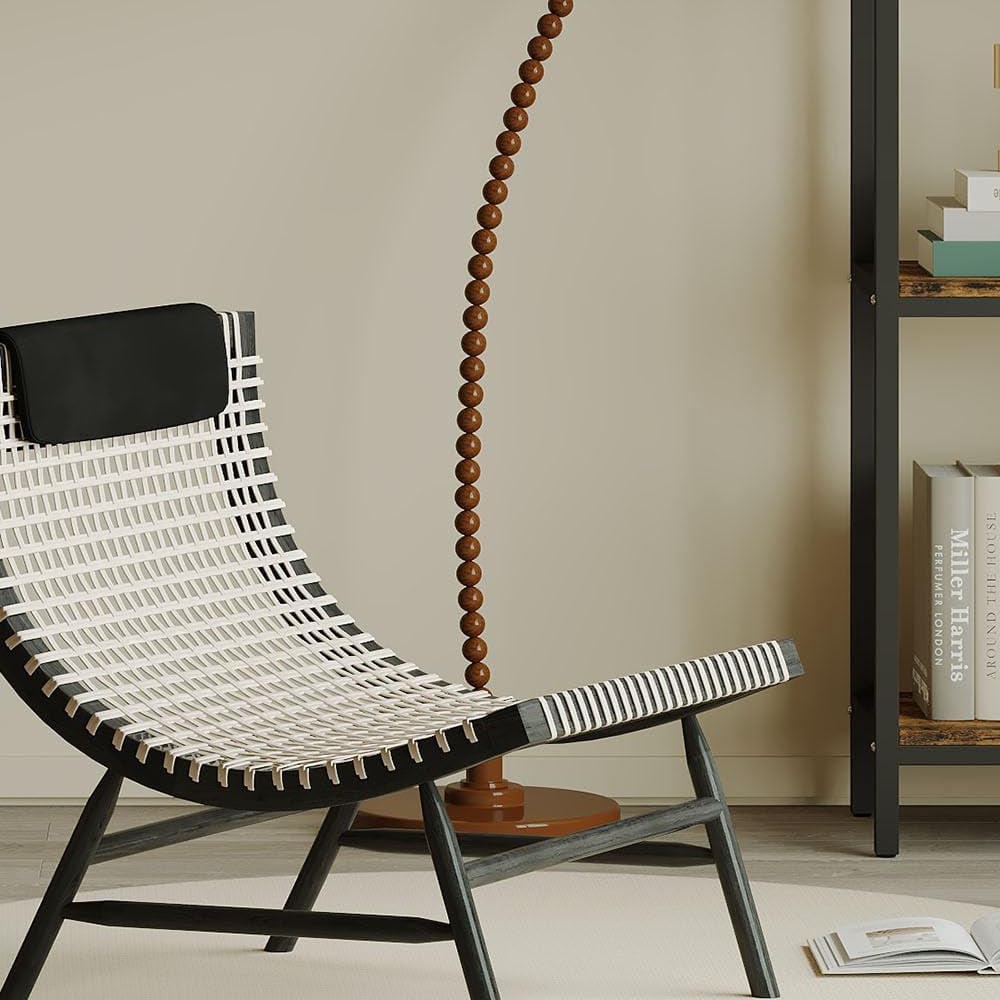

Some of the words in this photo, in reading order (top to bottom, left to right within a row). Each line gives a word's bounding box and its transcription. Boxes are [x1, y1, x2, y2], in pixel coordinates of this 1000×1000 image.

[950, 528, 969, 601] Miller
[986, 512, 997, 566] HOUSE
[934, 544, 944, 606] PERFUMER
[986, 573, 997, 606] THE
[934, 613, 944, 667] LONDON
[950, 607, 969, 683] Harris
[986, 612, 997, 680] AROUND
